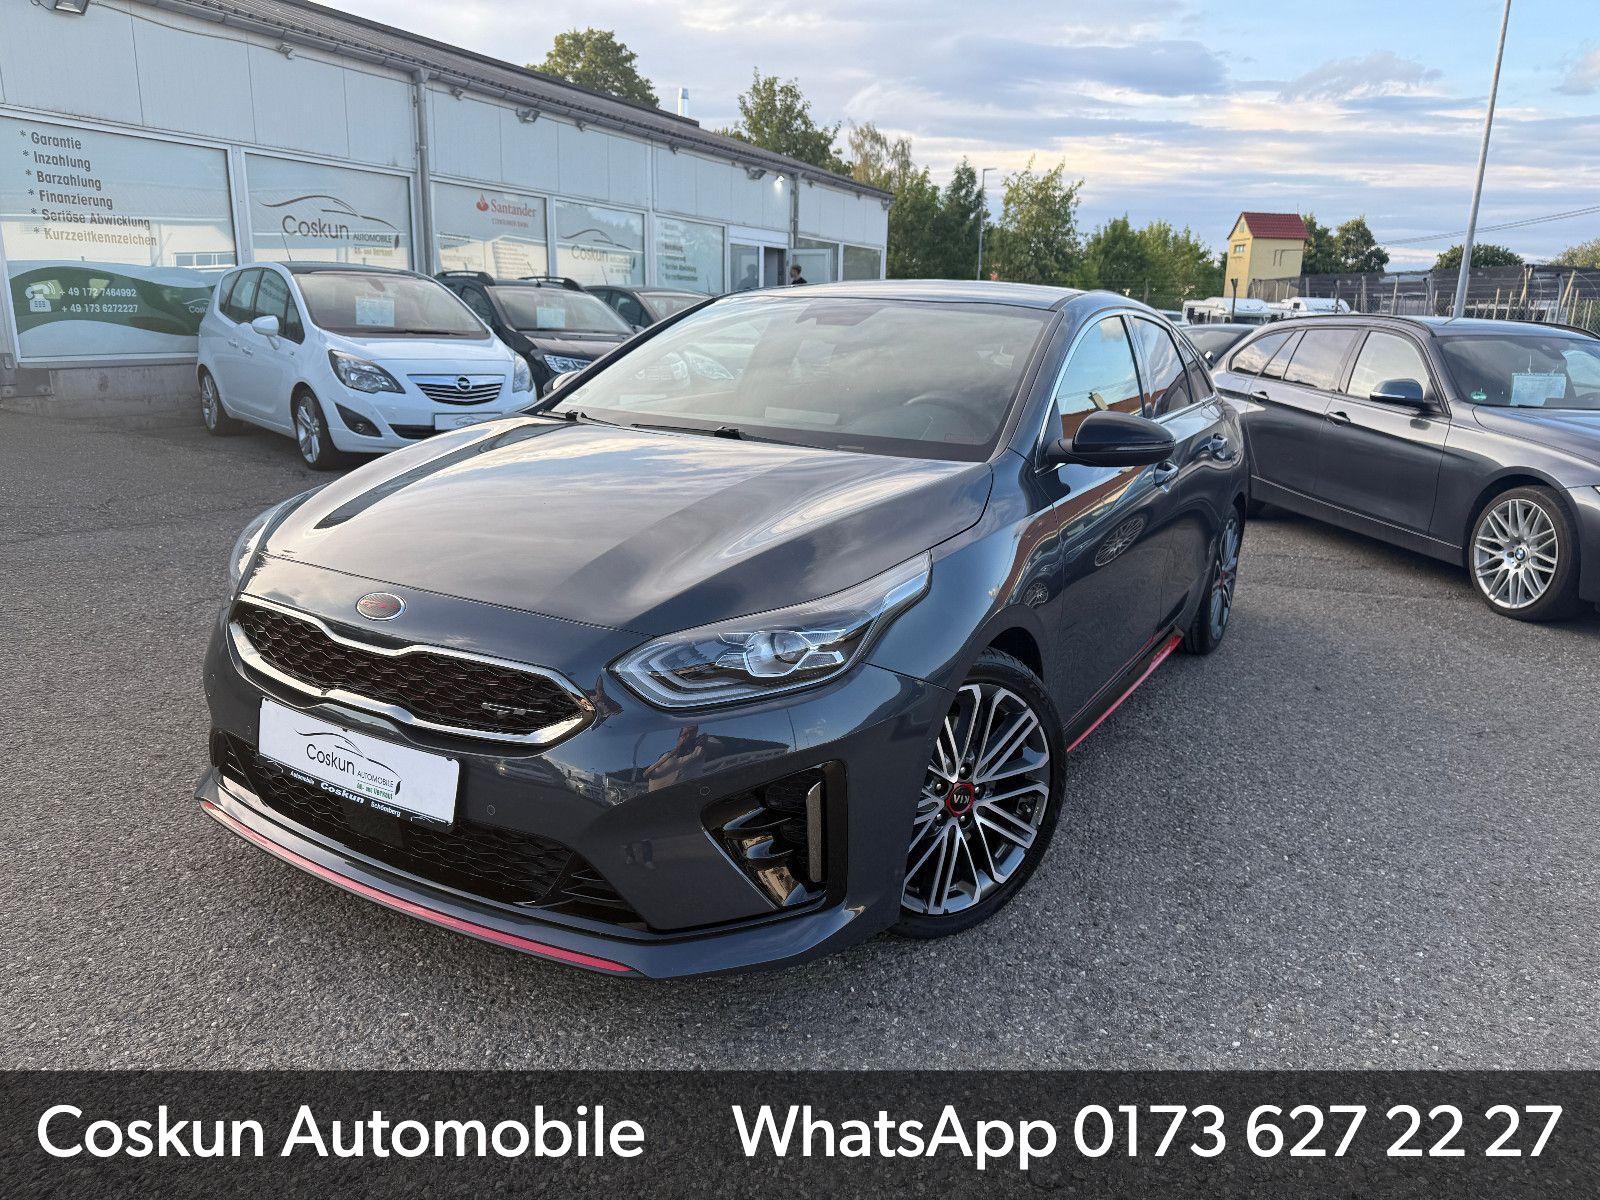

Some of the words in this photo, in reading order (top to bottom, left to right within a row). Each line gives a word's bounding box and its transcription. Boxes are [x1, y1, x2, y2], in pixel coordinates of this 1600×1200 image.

[31, 131, 82, 150] Garantie
[33, 151, 91, 172] Inzahlung
[36, 170, 102, 191] Barzahlung
[39, 189, 113, 211] Finanzierung
[491, 199, 536, 218] Santander
[41, 208, 86, 224] Seriöse
[90, 212, 151, 231] Abwicklung
[281, 214, 350, 240] Coskun
[353, 234, 392, 244] AUTOMOBILE
[44, 227, 157, 247] Kurzzeitkennzeichen
[571, 245, 609, 263] Coskun
[68, 287, 80, 297] 49
[82, 287, 99, 297] 172
[101, 288, 137, 297] 7464992
[70, 304, 82, 313] 49
[84, 304, 101, 313] 173
[102, 304, 138, 313] 6272227
[306, 743, 355, 776] Coskun
[357, 770, 394, 788] AUTOMOBILE
[320, 782, 365, 804] Coskun
